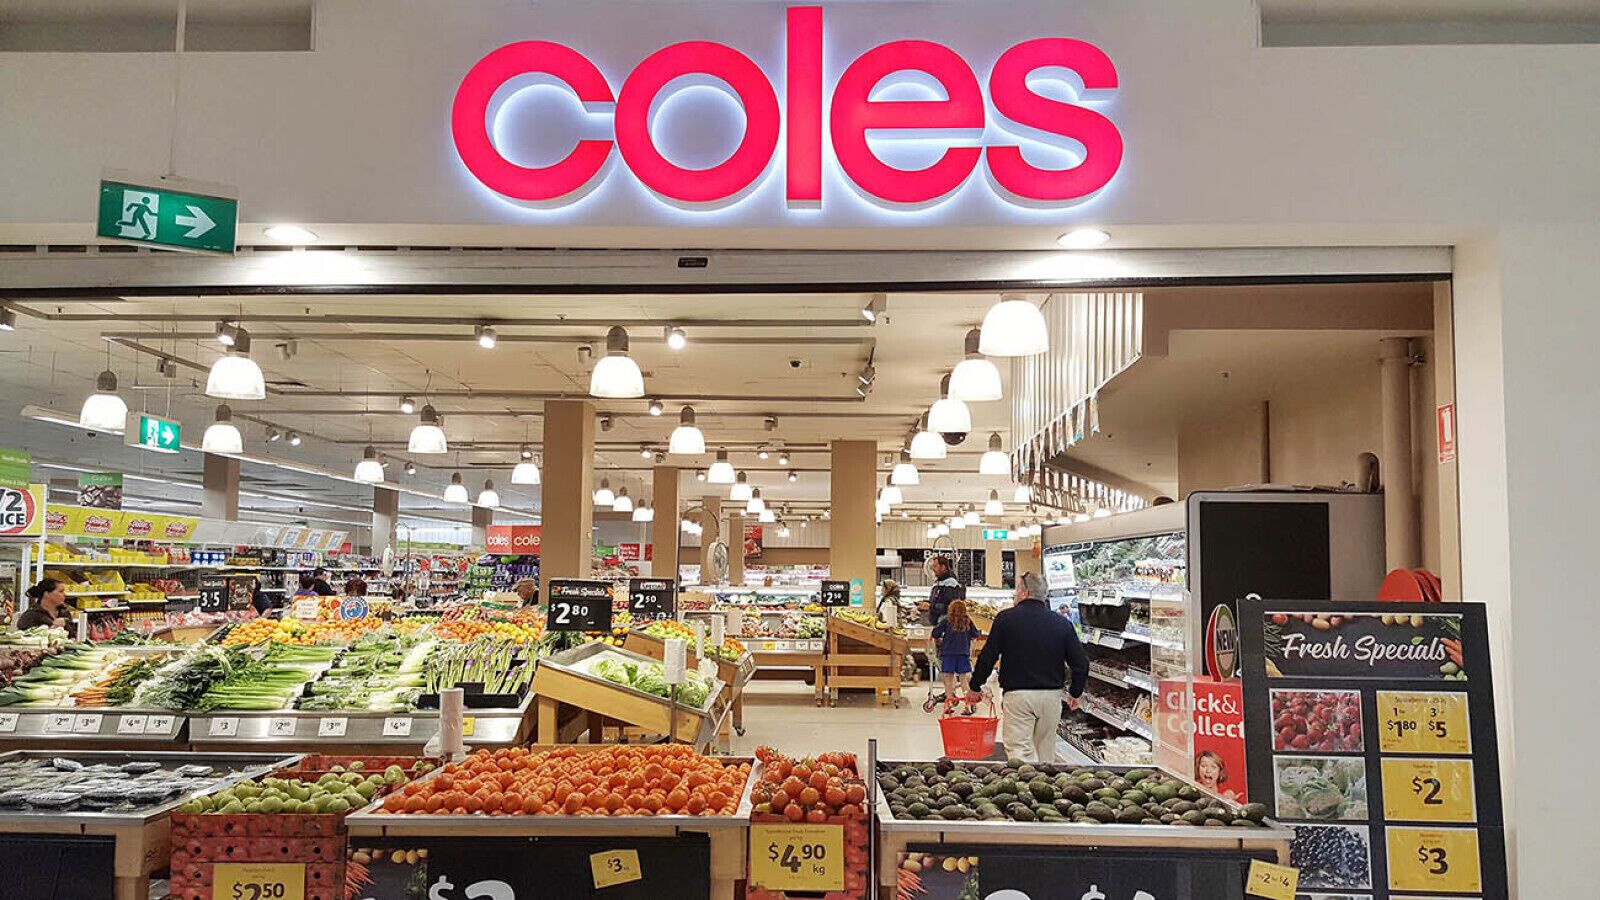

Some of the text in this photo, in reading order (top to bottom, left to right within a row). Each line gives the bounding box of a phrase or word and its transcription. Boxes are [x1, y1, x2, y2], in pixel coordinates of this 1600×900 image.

[451, 6, 1124, 206] coles
[487, 535, 509, 545] coles
[1282, 633, 1446, 667] Fresh Specials
[1428, 720, 1447, 738] $5
[1412, 776, 1443, 805] $2
[607, 858, 623, 873] $3
[812, 863, 825, 876] kg
[1418, 845, 1449, 875] $3
